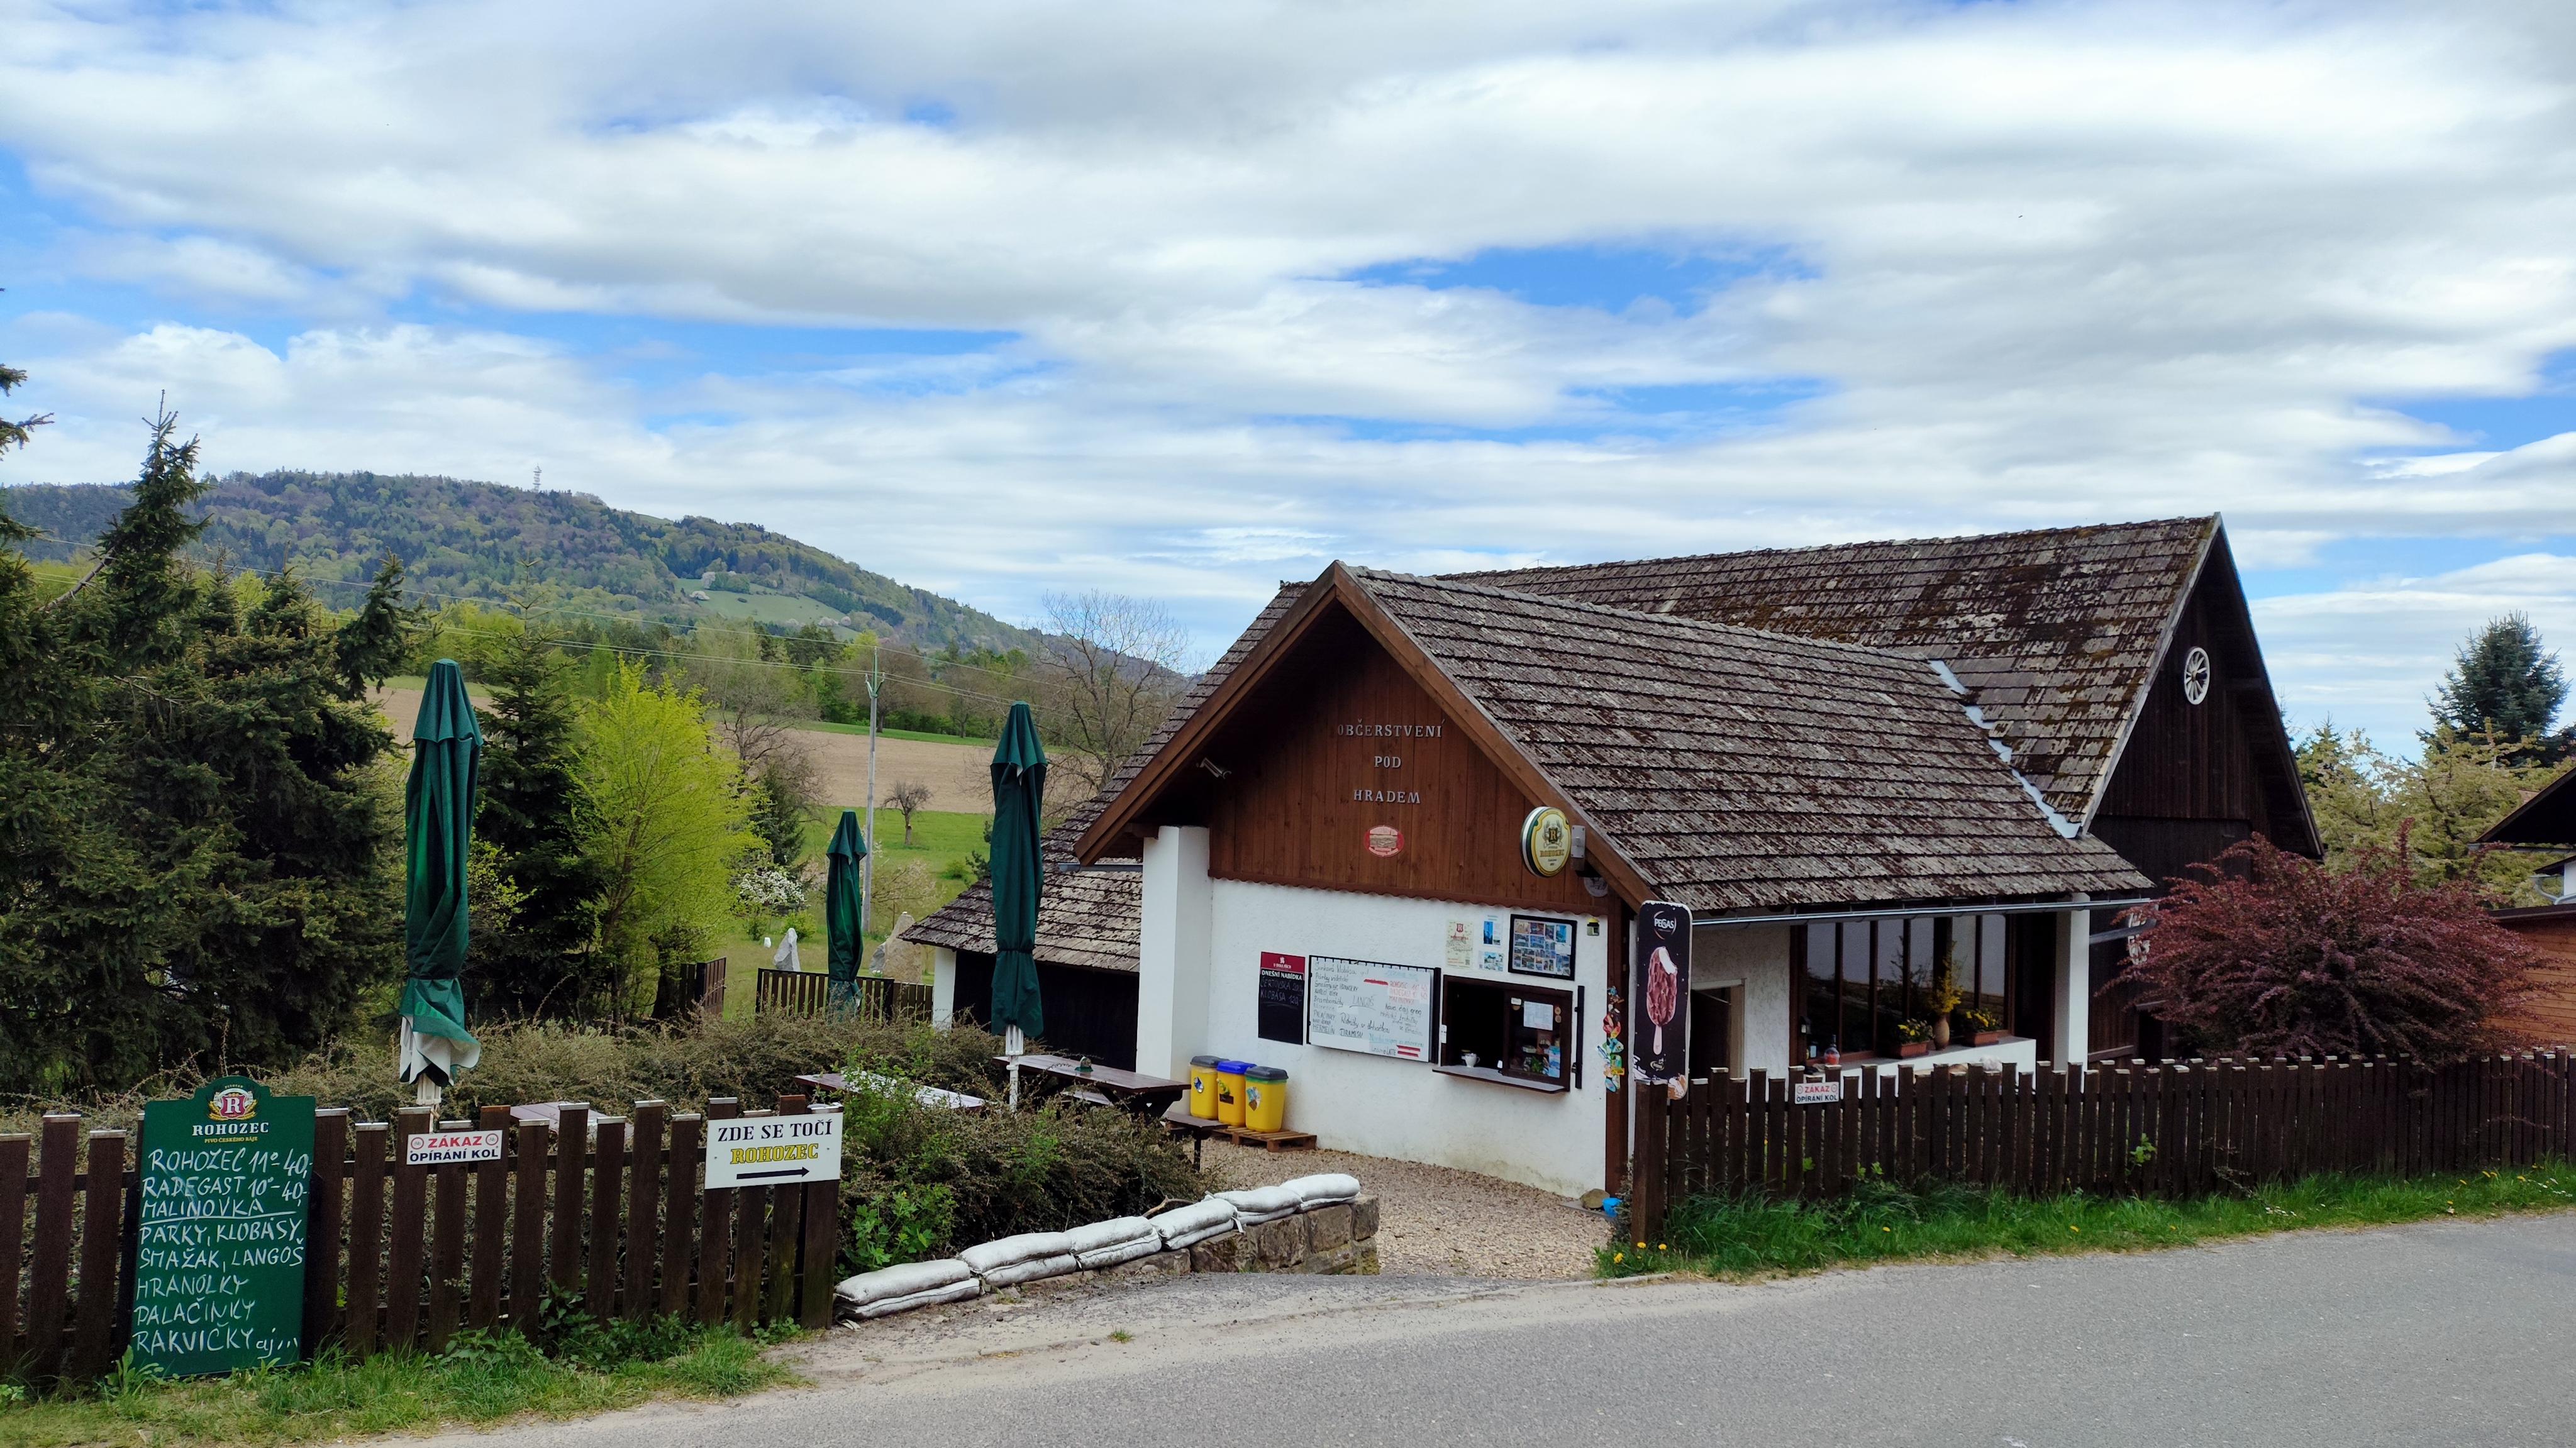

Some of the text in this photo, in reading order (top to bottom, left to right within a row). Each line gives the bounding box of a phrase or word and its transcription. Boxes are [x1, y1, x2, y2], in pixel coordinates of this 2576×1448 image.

[1338, 719, 1445, 738] OBČERSTVENÍ
[1374, 756, 1402, 768] POD
[1353, 790, 1421, 804] HRADEM
[1654, 918, 1674, 929] PEGAS
[1262, 970, 1302, 981] DNEŠNÍ NABÍDKA
[1797, 1093, 1823, 1102] OPÍRÁNÍ
[1805, 1085, 1829, 1093] ZÁKAZ
[225, 1097, 242, 1114] R
[192, 1122, 269, 1136] ROHOZEC
[718, 1119, 833, 1142] ZDE SE TOČÍ
[428, 1135, 482, 1148] ZÁKAZ
[148, 1147, 246, 1172] ROHOZEC
[409, 1148, 498, 1162] OPÍRÁNÍ KOL
[730, 1143, 819, 1164] ROHOZEC
[142, 1176, 246, 1198] RADEGAST
[142, 1197, 264, 1219] MALINOVKA
[231, 1238, 304, 1266] LANGOŠ
[136, 1274, 250, 1301] HRANOLKY
[133, 1296, 256, 1326] PALAČINKY
[132, 1322, 254, 1356] RAKVIČKY
